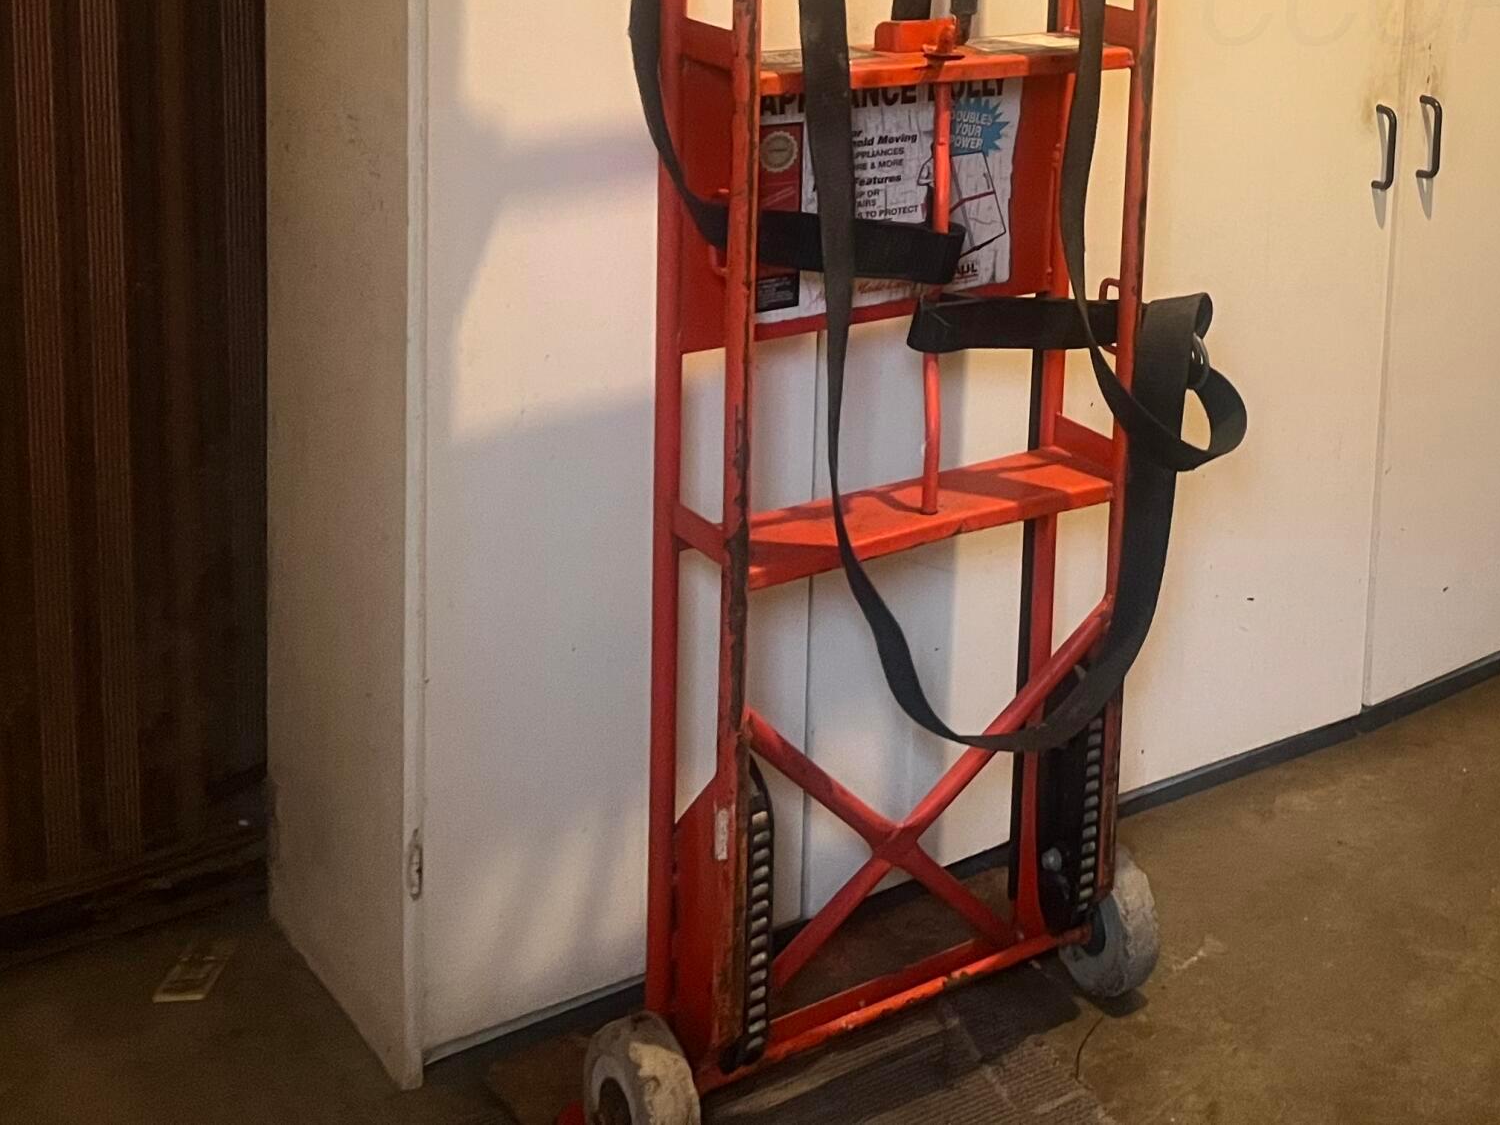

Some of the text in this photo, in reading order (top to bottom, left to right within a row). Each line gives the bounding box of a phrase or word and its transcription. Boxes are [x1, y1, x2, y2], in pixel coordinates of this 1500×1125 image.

[955, 123, 983, 137] YOUR
[877, 132, 918, 146] Moving
[854, 146, 905, 159] PPLIANCES
[878, 204, 919, 217] PROTECT
